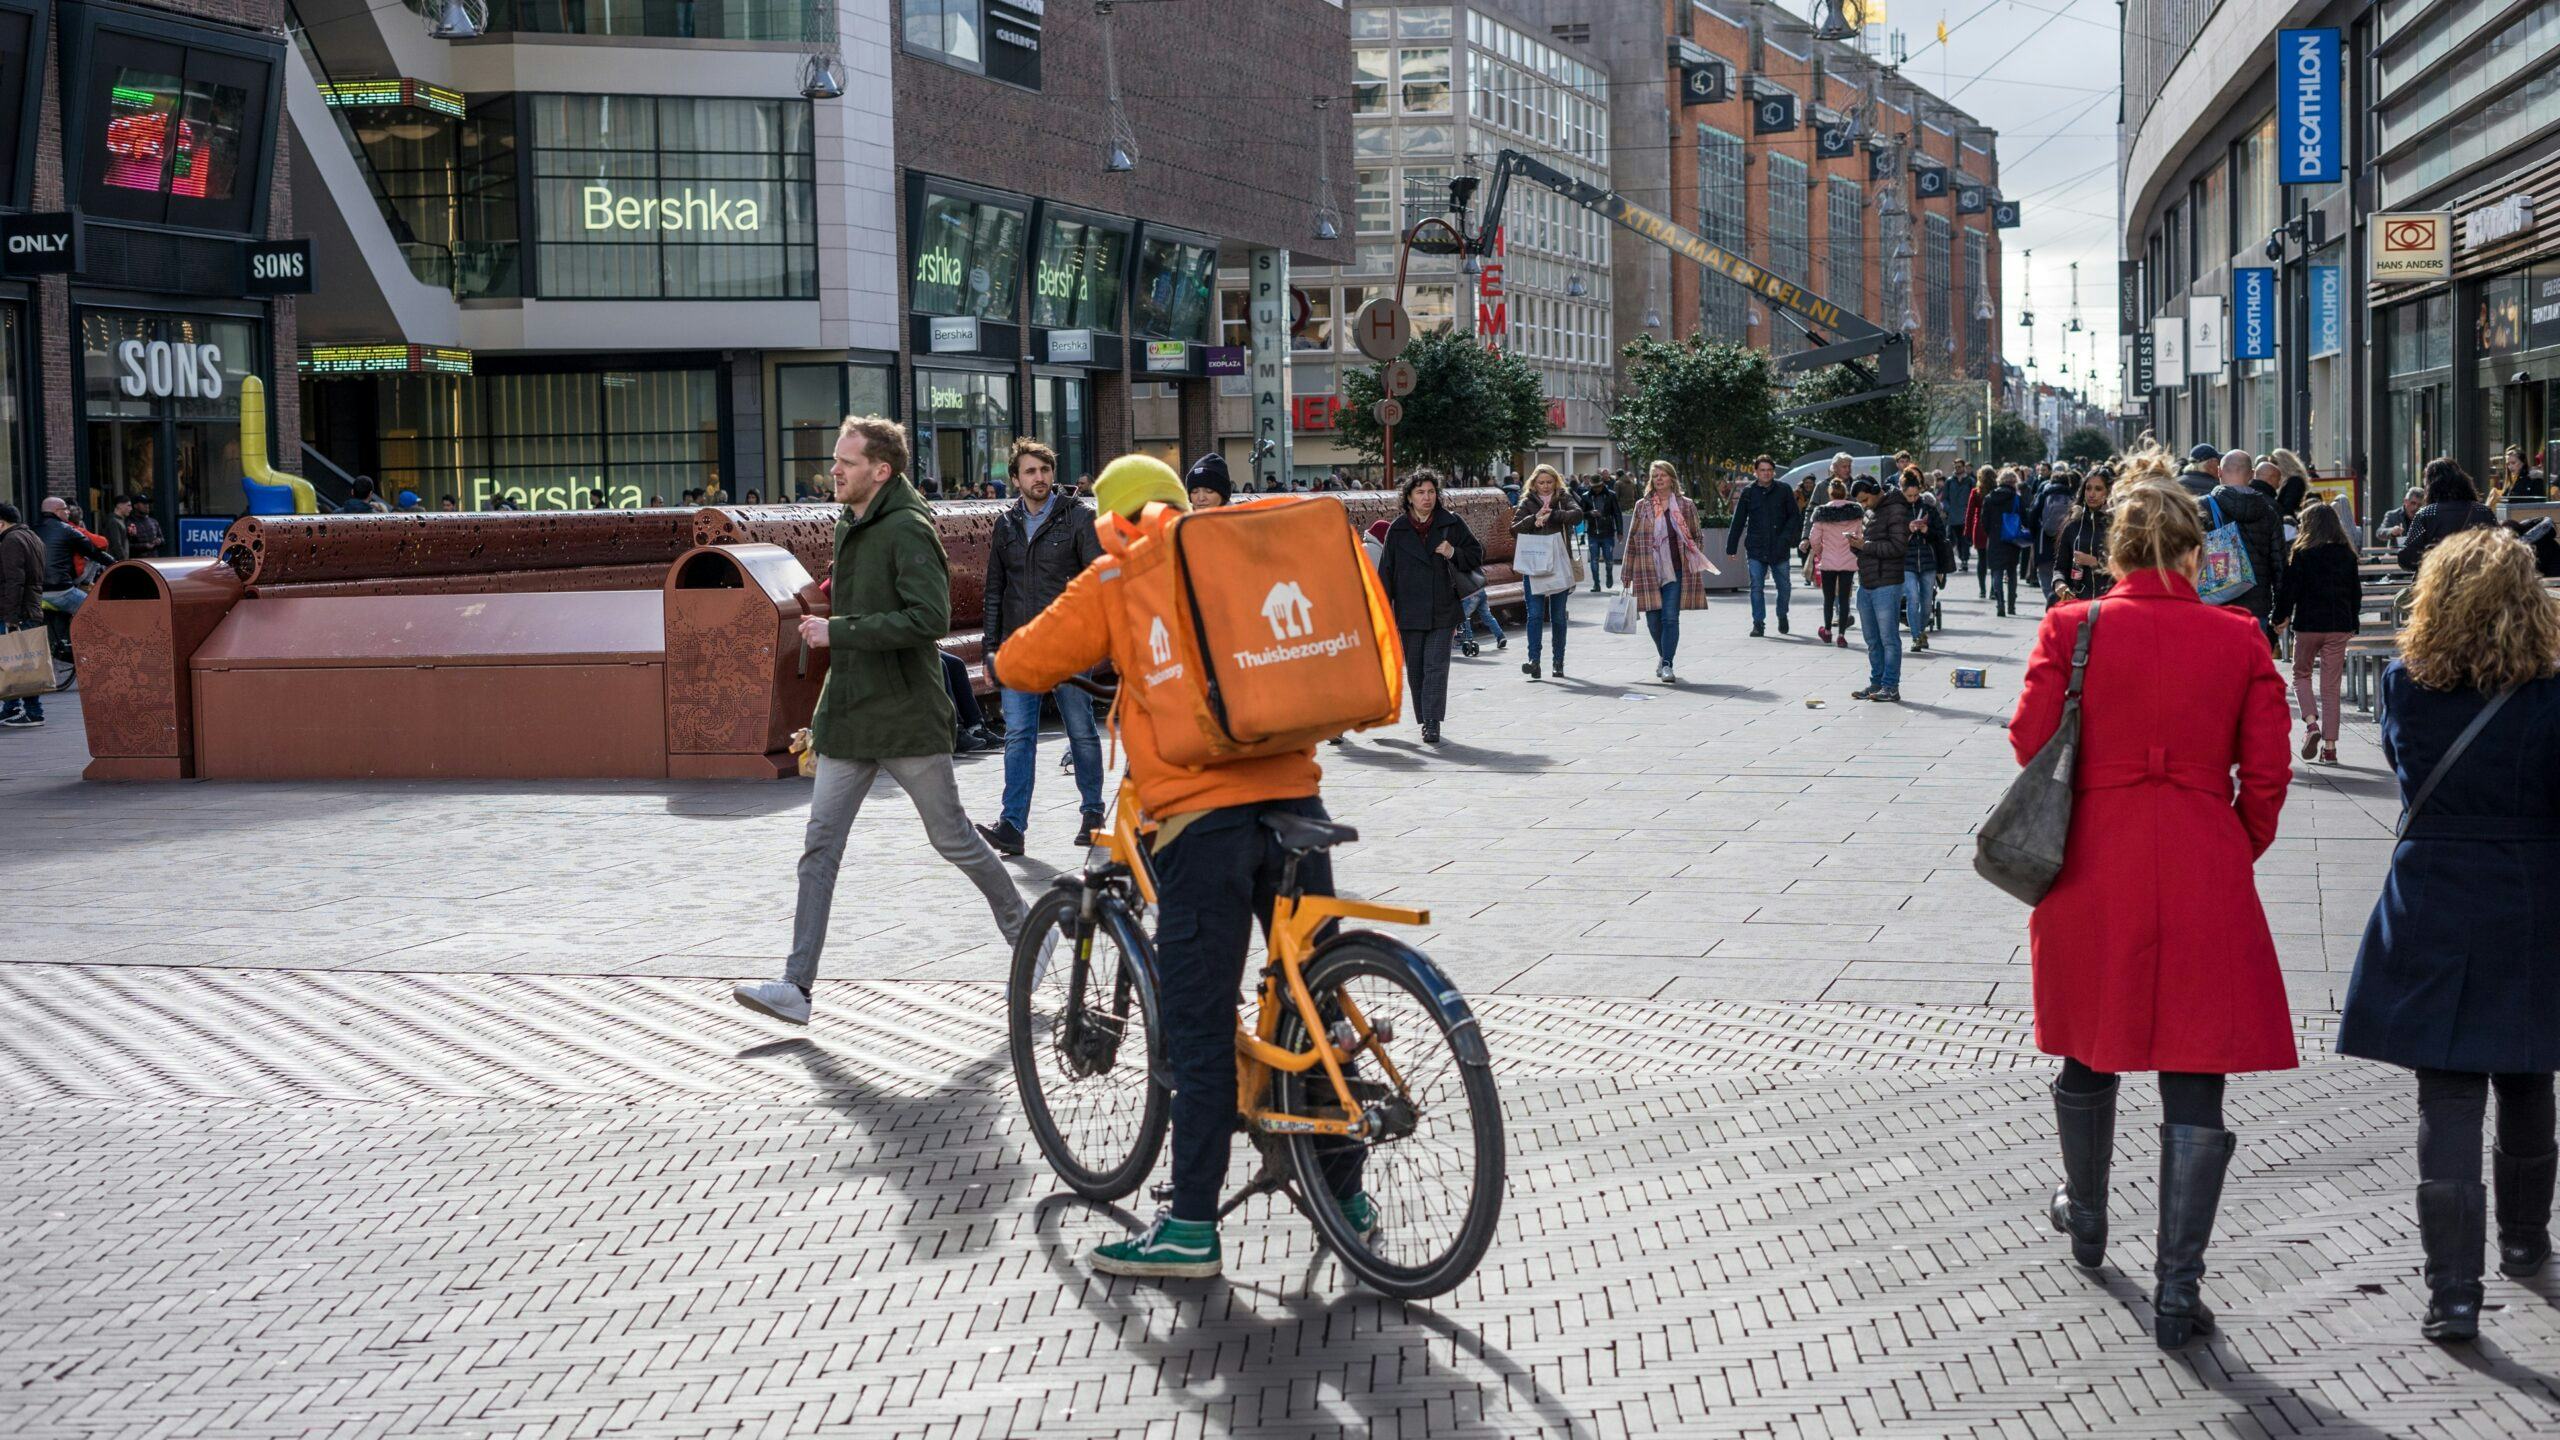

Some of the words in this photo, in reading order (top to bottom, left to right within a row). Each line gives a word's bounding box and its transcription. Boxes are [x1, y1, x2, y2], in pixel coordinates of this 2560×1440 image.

[2298, 36, 2321, 175] DECATHLON
[584, 187, 758, 230] Bershka
[8, 234, 68, 253] ONLY
[253, 253, 303, 278] SONS
[1038, 260, 1088, 301] Bersha
[2377, 261, 2402, 269] HANS
[2406, 260, 2443, 269] ANDERS
[2124, 276, 2134, 321] TOPSHOP
[2247, 272, 2261, 355] DECATHLON
[935, 329, 973, 340] Bershka
[1372, 309, 1395, 340] H
[1052, 340, 1088, 351] Bershka
[2140, 336, 2153, 393] GUESS
[119, 340, 222, 399] SONS
[930, 386, 963, 409] Bershka
[1233, 629, 1360, 669] Thuisbezorgd.nl
